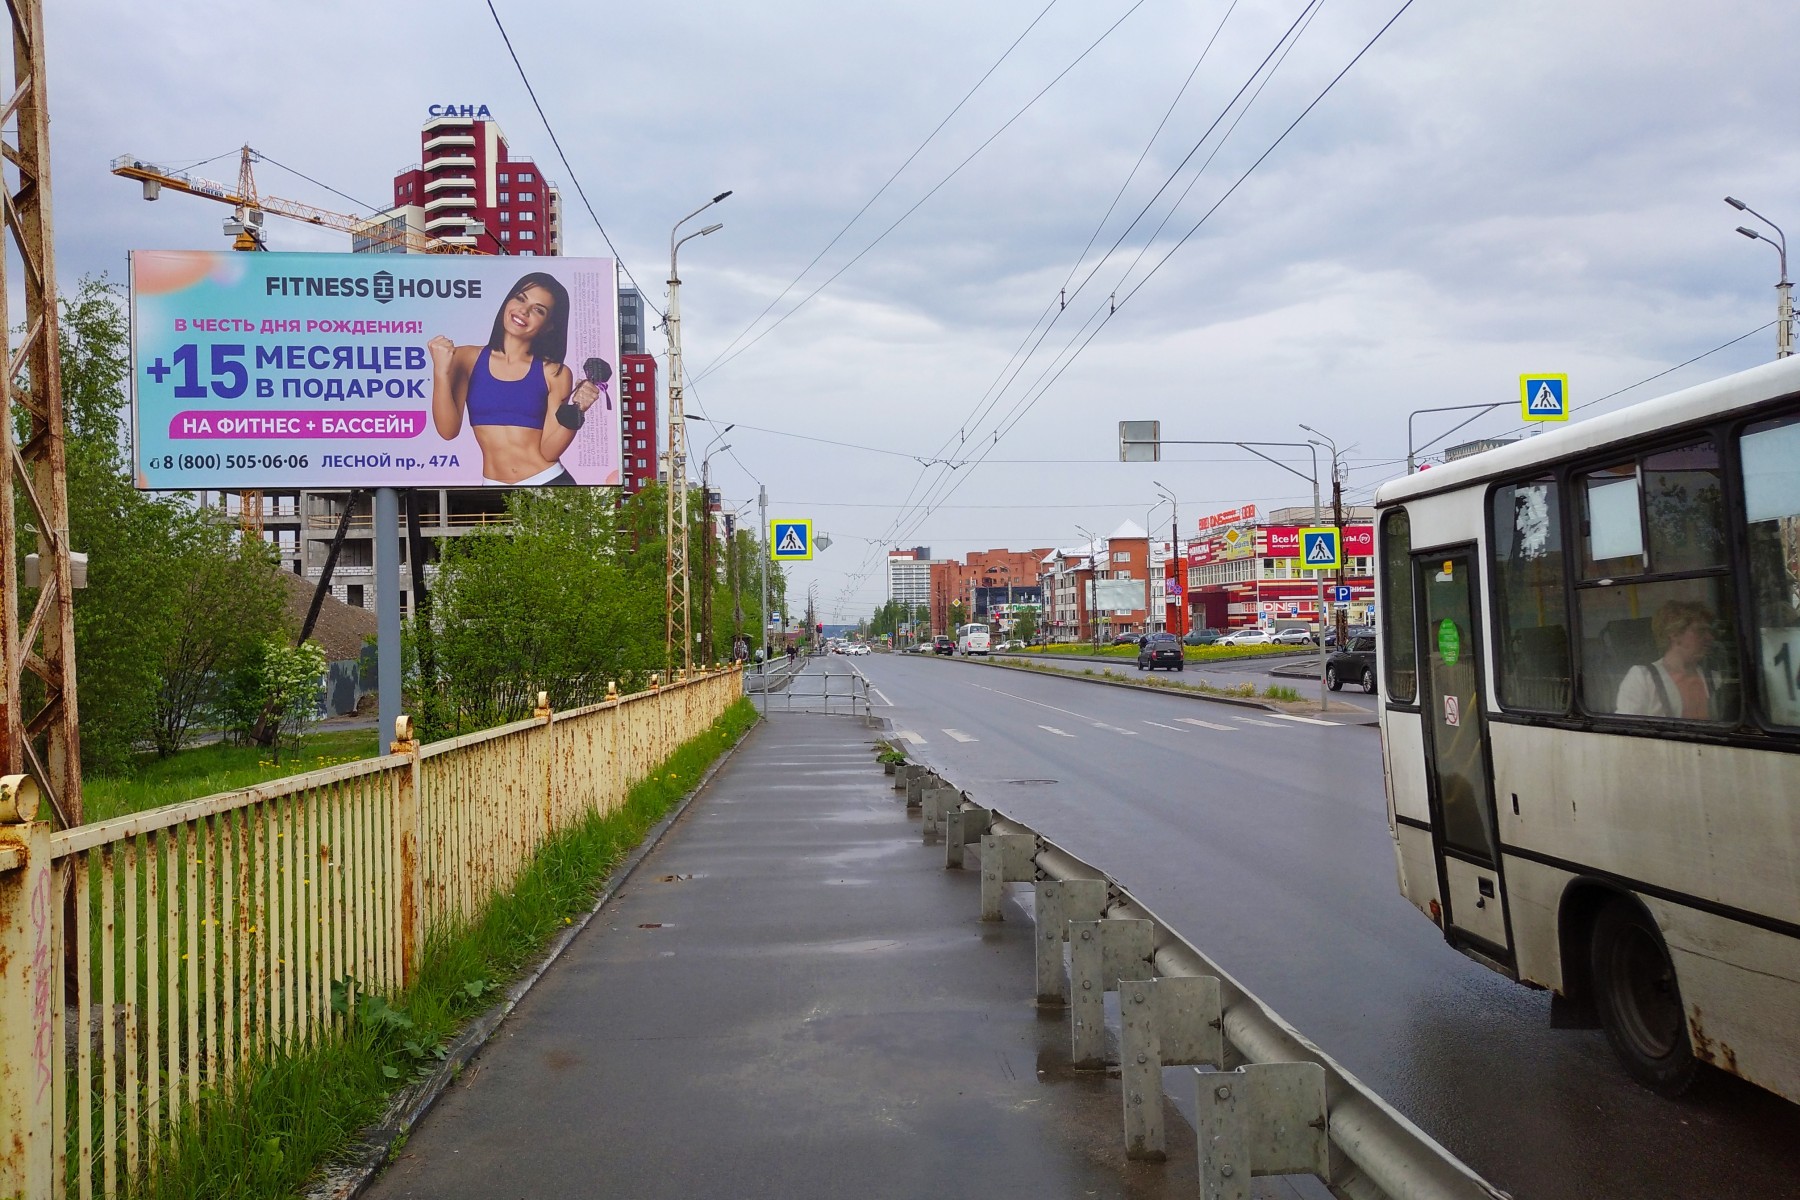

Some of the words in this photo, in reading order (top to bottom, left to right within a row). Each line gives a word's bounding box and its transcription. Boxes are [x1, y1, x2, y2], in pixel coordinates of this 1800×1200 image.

[428, 104, 491, 117] САНА
[266, 277, 369, 298] FITNESS
[399, 278, 482, 299] HOUSE
[174, 319, 187, 332] В
[192, 319, 255, 332] ЧЕСТЬ
[260, 320, 301, 334] ДНЯ
[306, 320, 423, 335] РОЖДЕНИЯ!
[147, 344, 249, 399] +15
[255, 345, 427, 374] МЕСЯЦЕВ
[256, 378, 275, 398] В
[183, 418, 212, 434] НА
[217, 417, 301, 434] ФИТНЕС
[322, 414, 414, 434] БАССЕЙН
[163, 455, 174, 469] 8
[178, 454, 221, 470] (800)
[321, 452, 391, 468] ЛЕСНОЙ
[395, 457, 425, 470] пр.,
[1263, 602, 1298, 611] DNS
